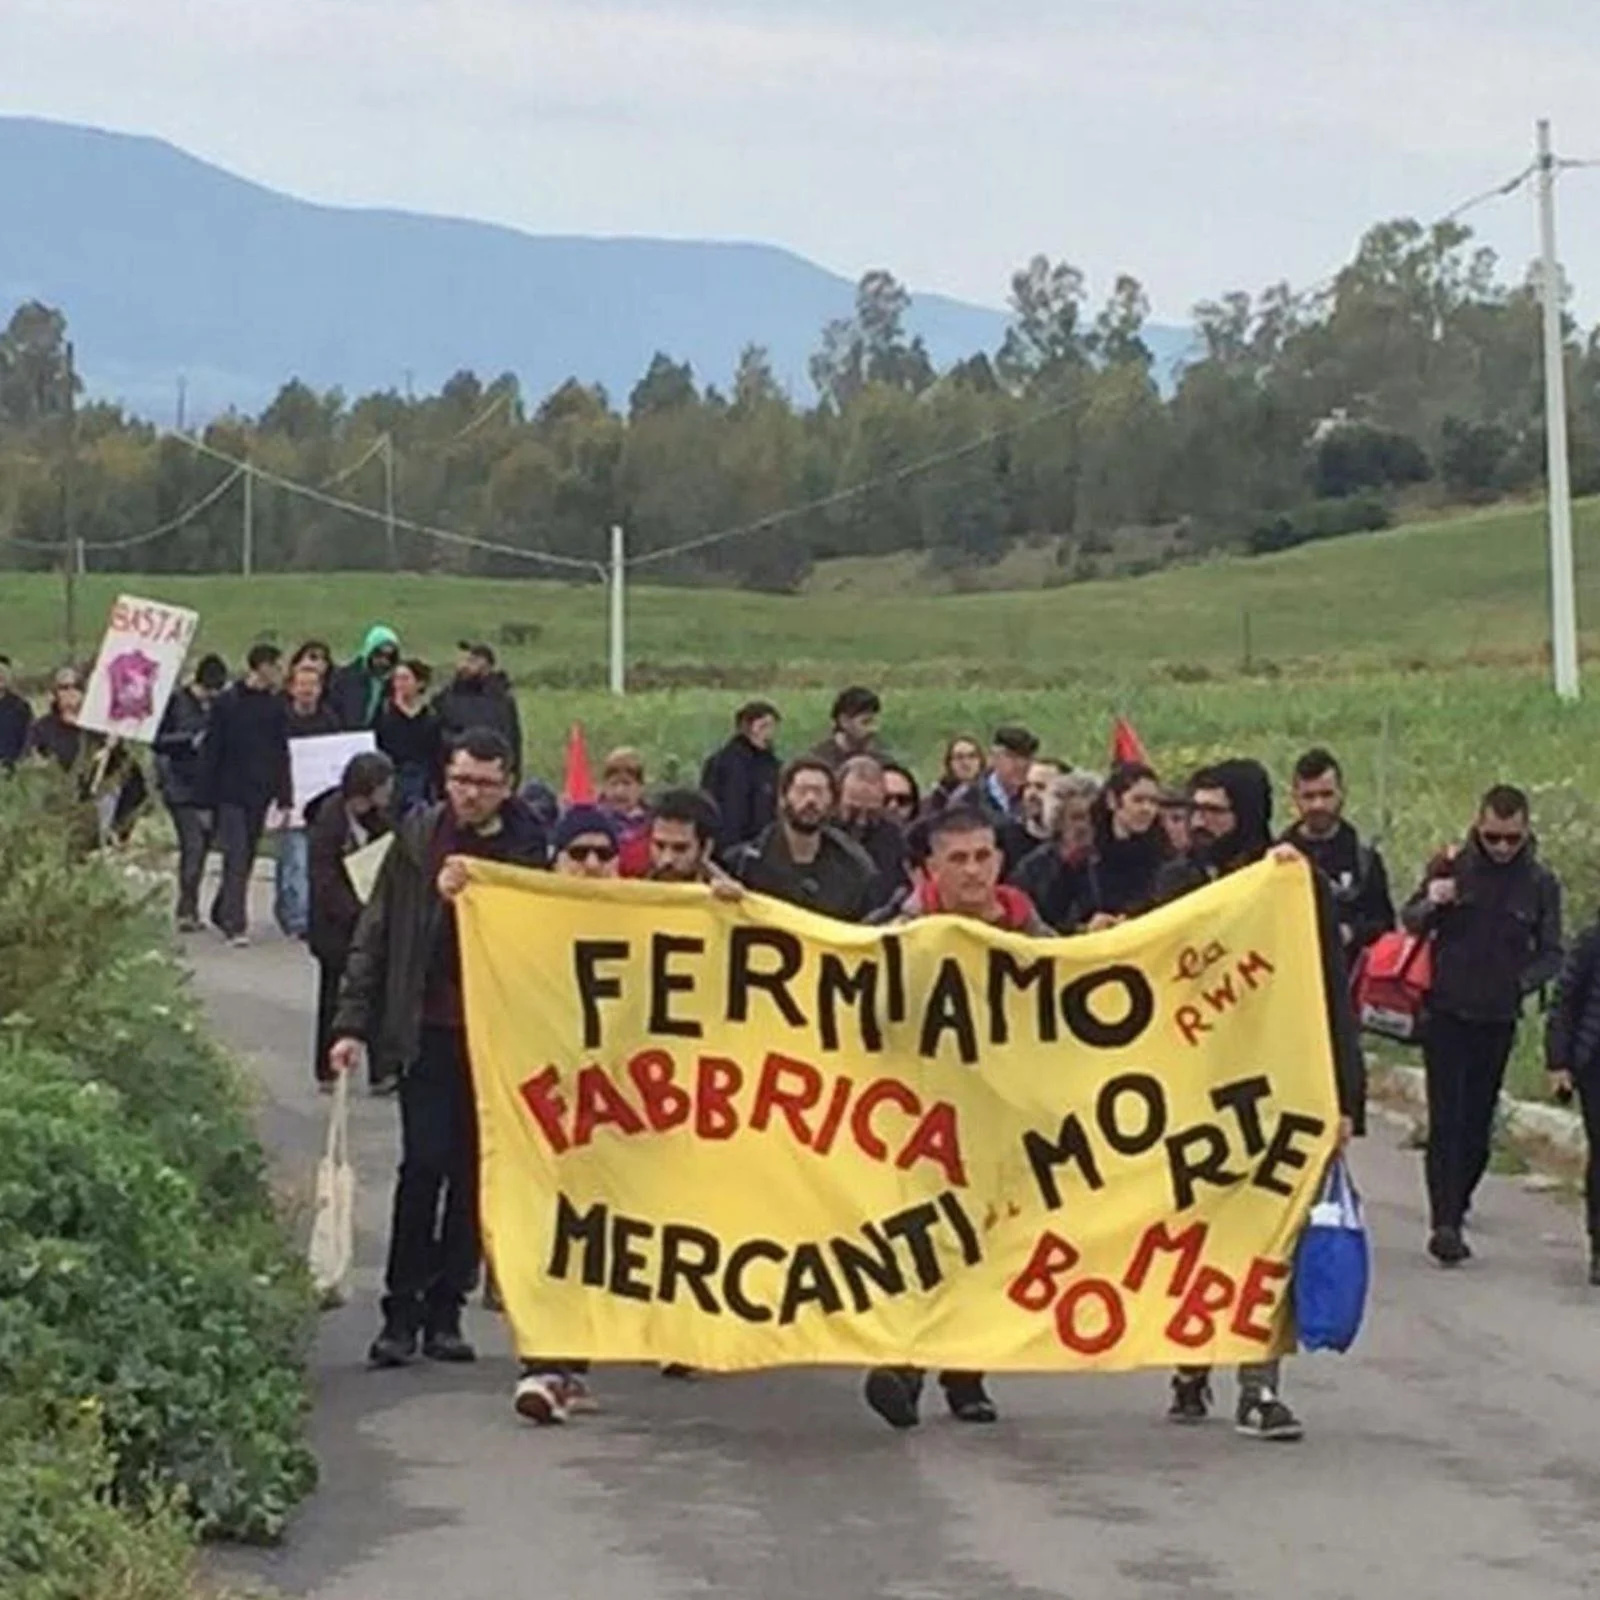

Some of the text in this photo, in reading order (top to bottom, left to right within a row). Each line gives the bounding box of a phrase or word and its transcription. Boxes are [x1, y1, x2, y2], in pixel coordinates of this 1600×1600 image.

[574, 926, 1154, 1064] FERMIAMO
[1175, 950, 1275, 1047] RWM
[519, 1049, 969, 1188] FABBRICA
[548, 1191, 981, 1325] MERCANTI
[1023, 1073, 1326, 1211] MORTE
[1007, 1221, 1291, 1355] BOMBE
